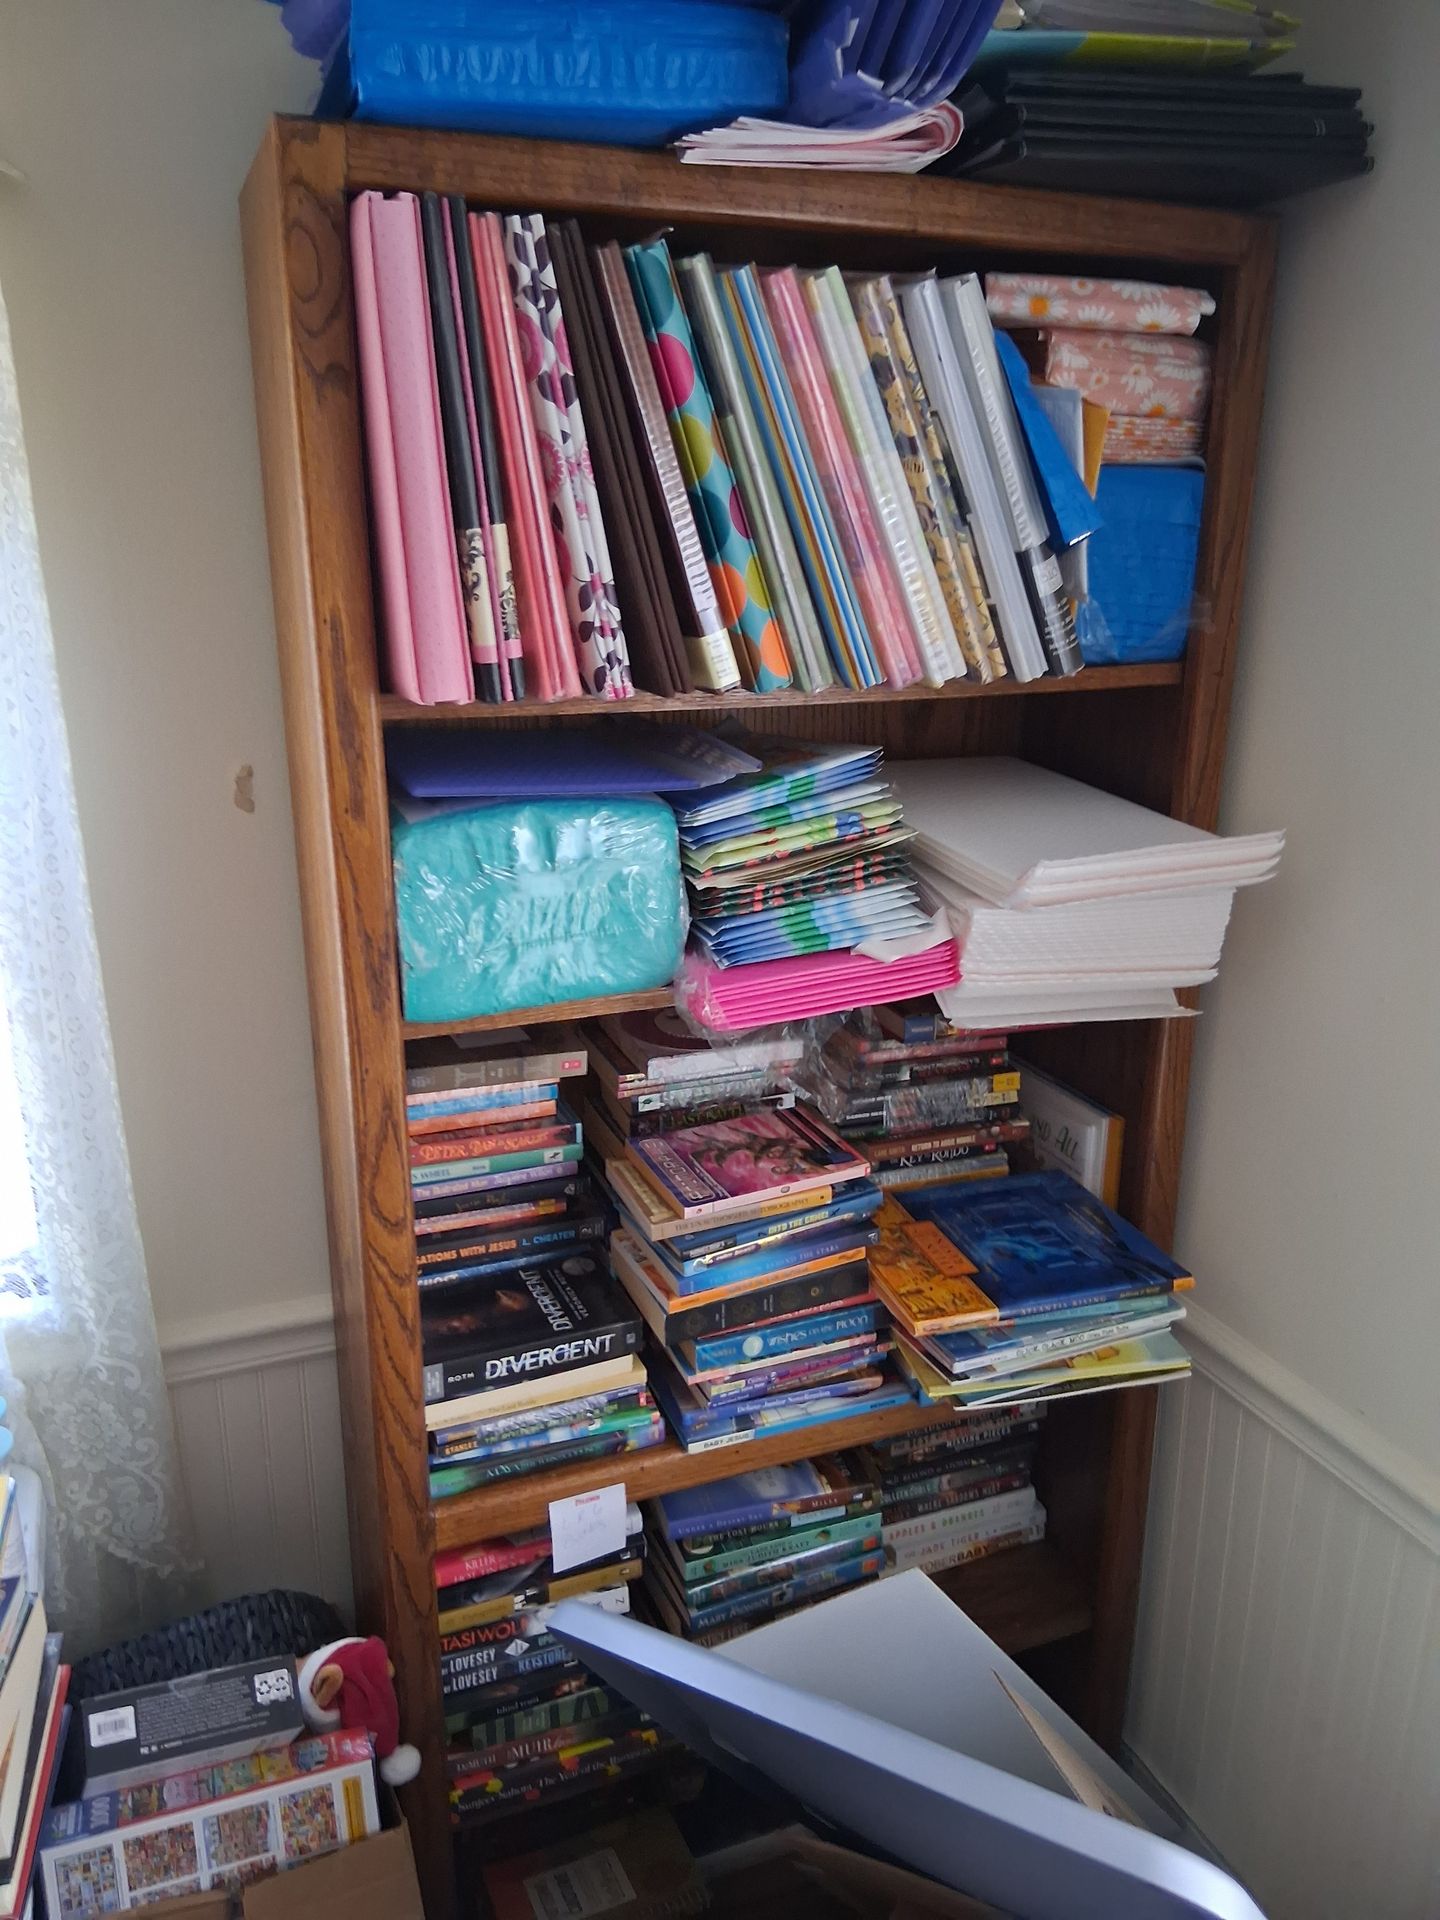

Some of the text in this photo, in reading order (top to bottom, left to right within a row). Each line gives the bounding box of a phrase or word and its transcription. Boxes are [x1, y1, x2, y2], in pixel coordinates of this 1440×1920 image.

[900, 1151, 922, 1167] KEY
[459, 1244, 486, 1257] WITH
[487, 1239, 518, 1253] JESUS
[518, 1268, 574, 1332] DIVERGENT
[447, 1333, 616, 1384] ROTH DIVERGENT
[450, 1647, 497, 1673] LOVESEY
[452, 1666, 498, 1692] LOVESEY
